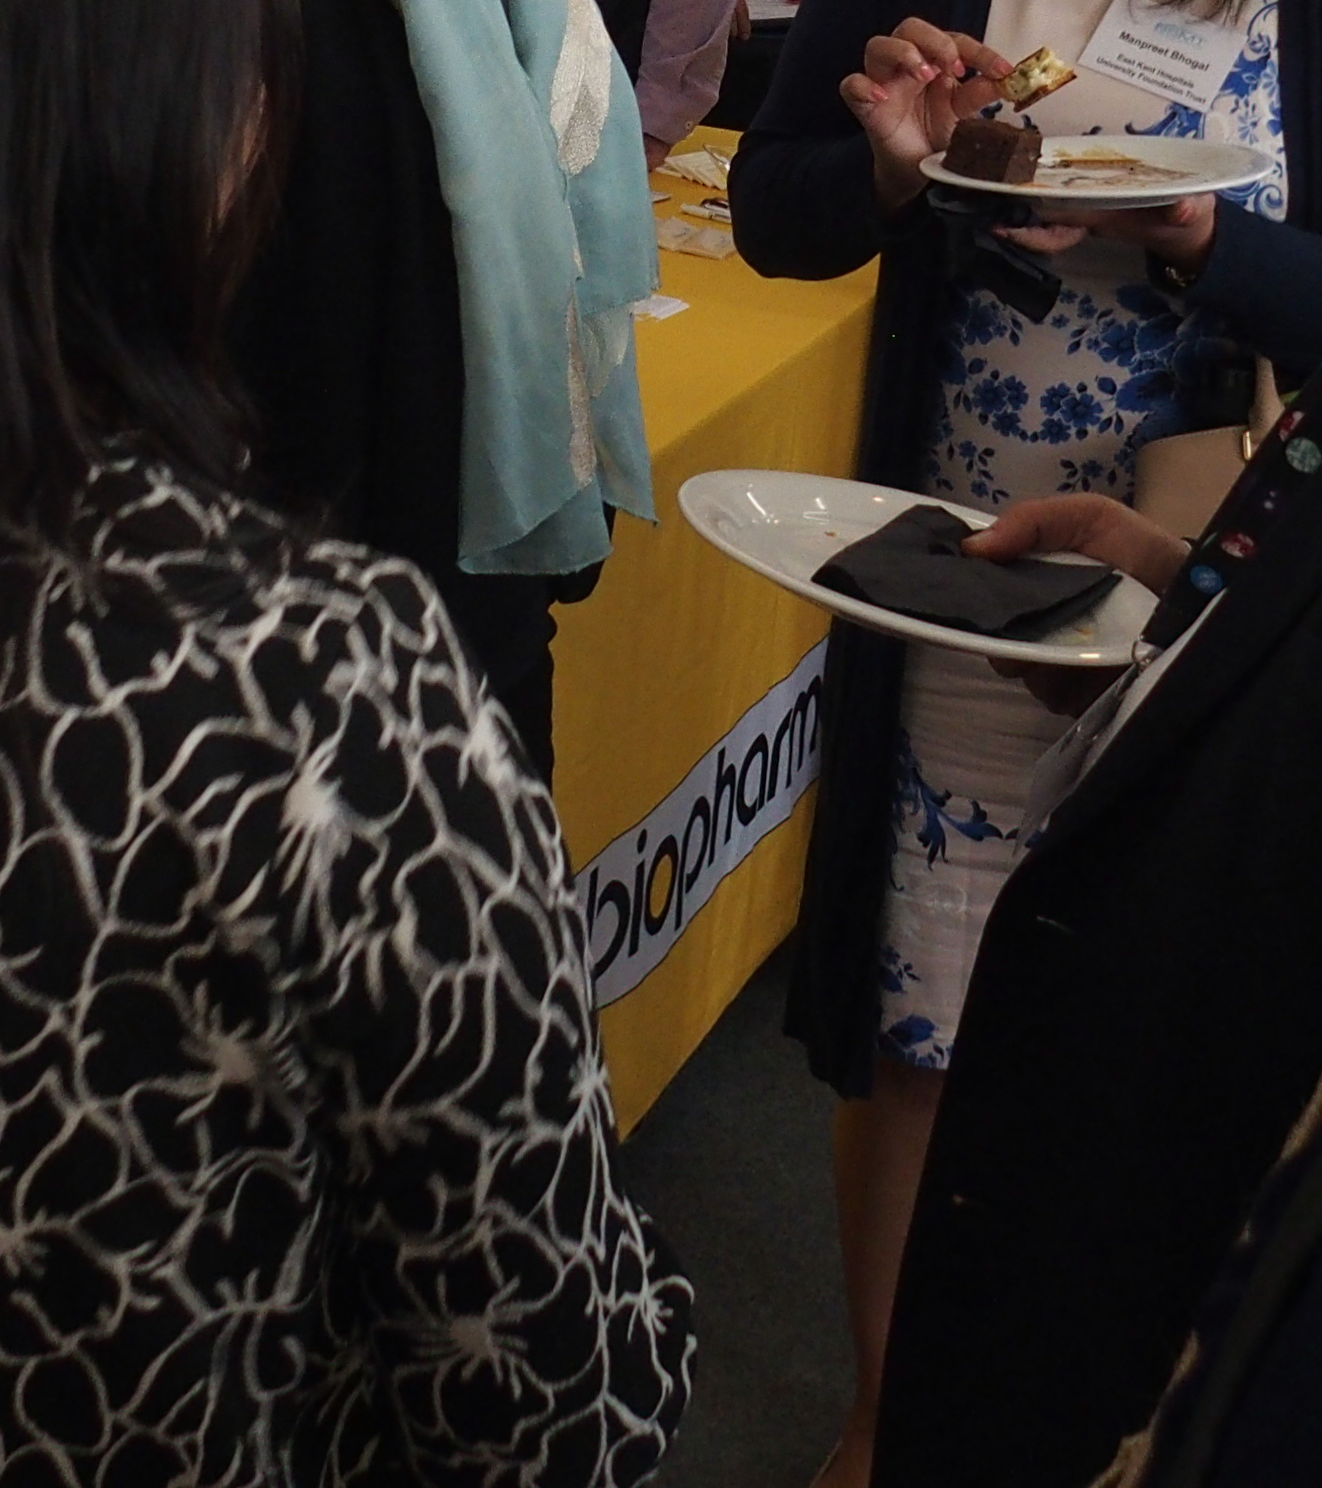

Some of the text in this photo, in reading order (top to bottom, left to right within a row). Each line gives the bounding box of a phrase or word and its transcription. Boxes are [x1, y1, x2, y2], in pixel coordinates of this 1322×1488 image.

[1119, 31, 1169, 57] Manpreet
[1170, 50, 1210, 71] Bhogal
[1096, 56, 1136, 77] University
[1137, 73, 1183, 95] Foundation
